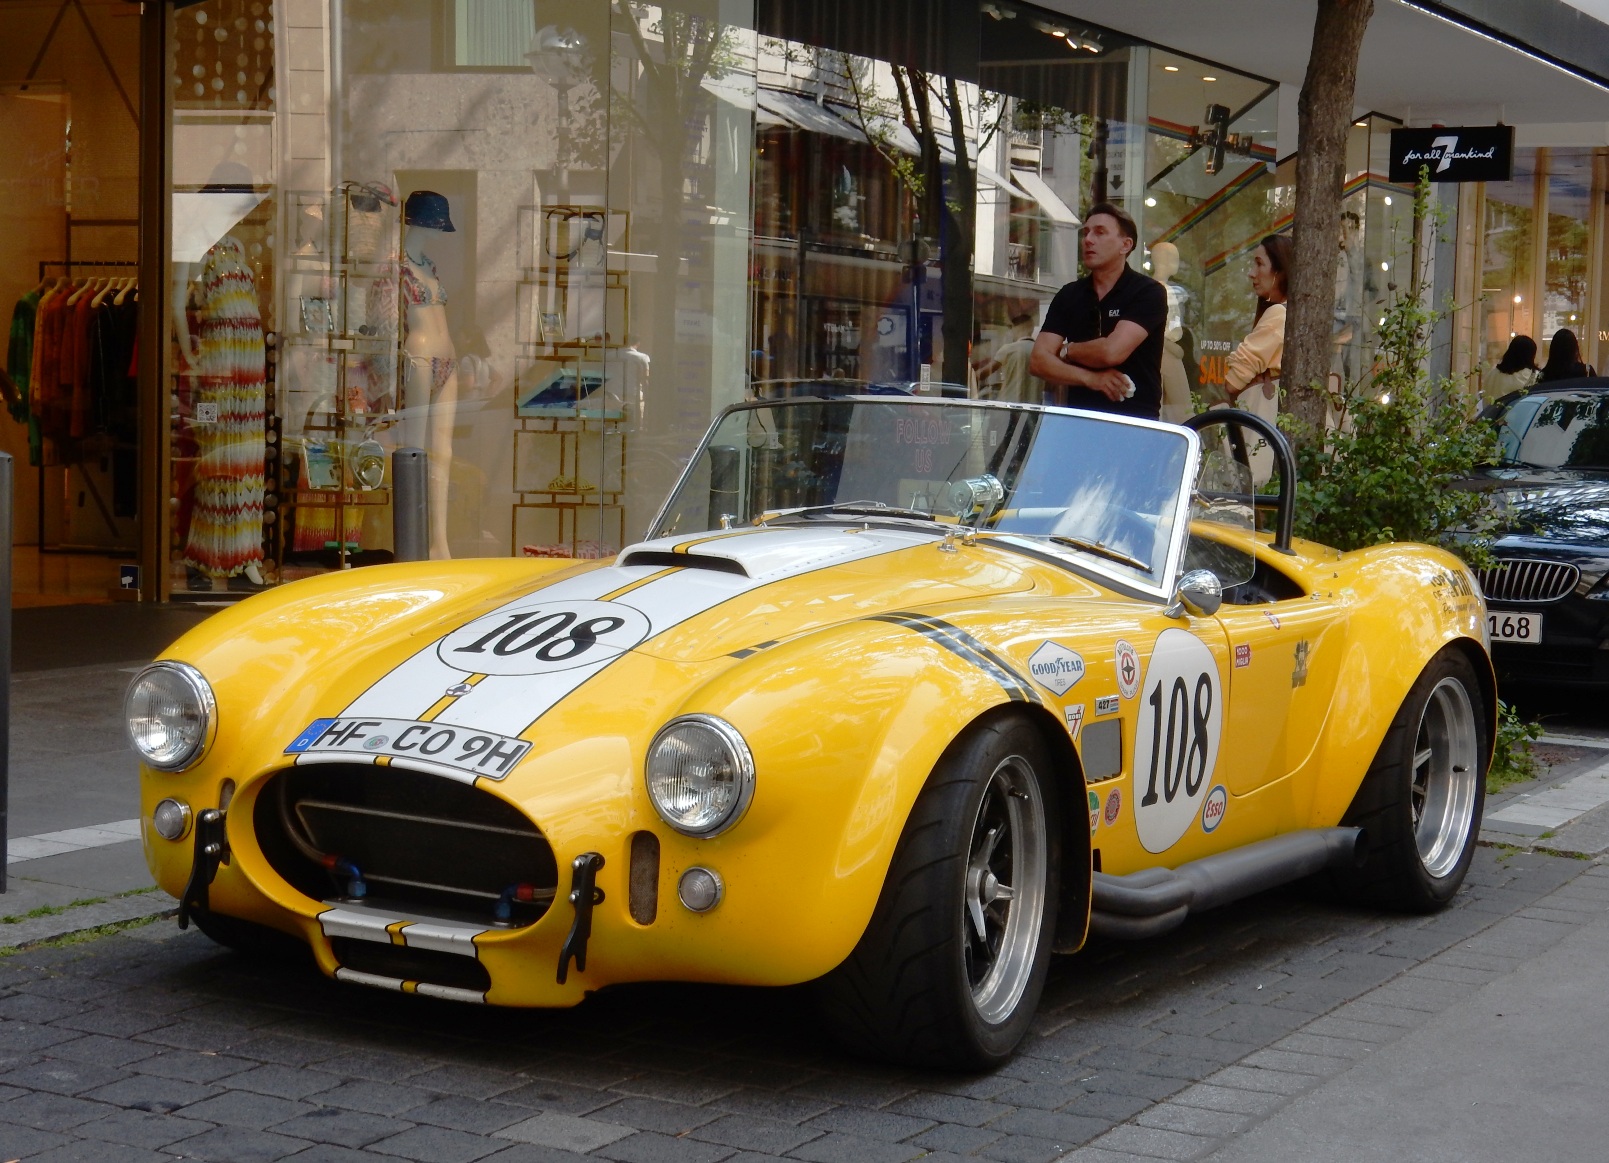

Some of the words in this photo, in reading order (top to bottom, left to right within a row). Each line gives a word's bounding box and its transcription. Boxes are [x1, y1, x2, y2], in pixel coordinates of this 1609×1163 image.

[1402, 149, 1422, 165] for
[1424, 149, 1441, 160] all
[1444, 146, 1495, 160] mankind
[1431, 135, 1459, 174] 7
[896, 419, 952, 445] FOLLOW
[915, 448, 933, 473] US
[453, 610, 626, 662] 108
[1488, 615, 1530, 639] 168
[1098, 699, 1110, 711] 427
[296, 738, 308, 747] D
[311, 721, 382, 748] HF
[391, 725, 457, 756] CO
[455, 735, 526, 772] 9H
[1141, 672, 1213, 807] 108
